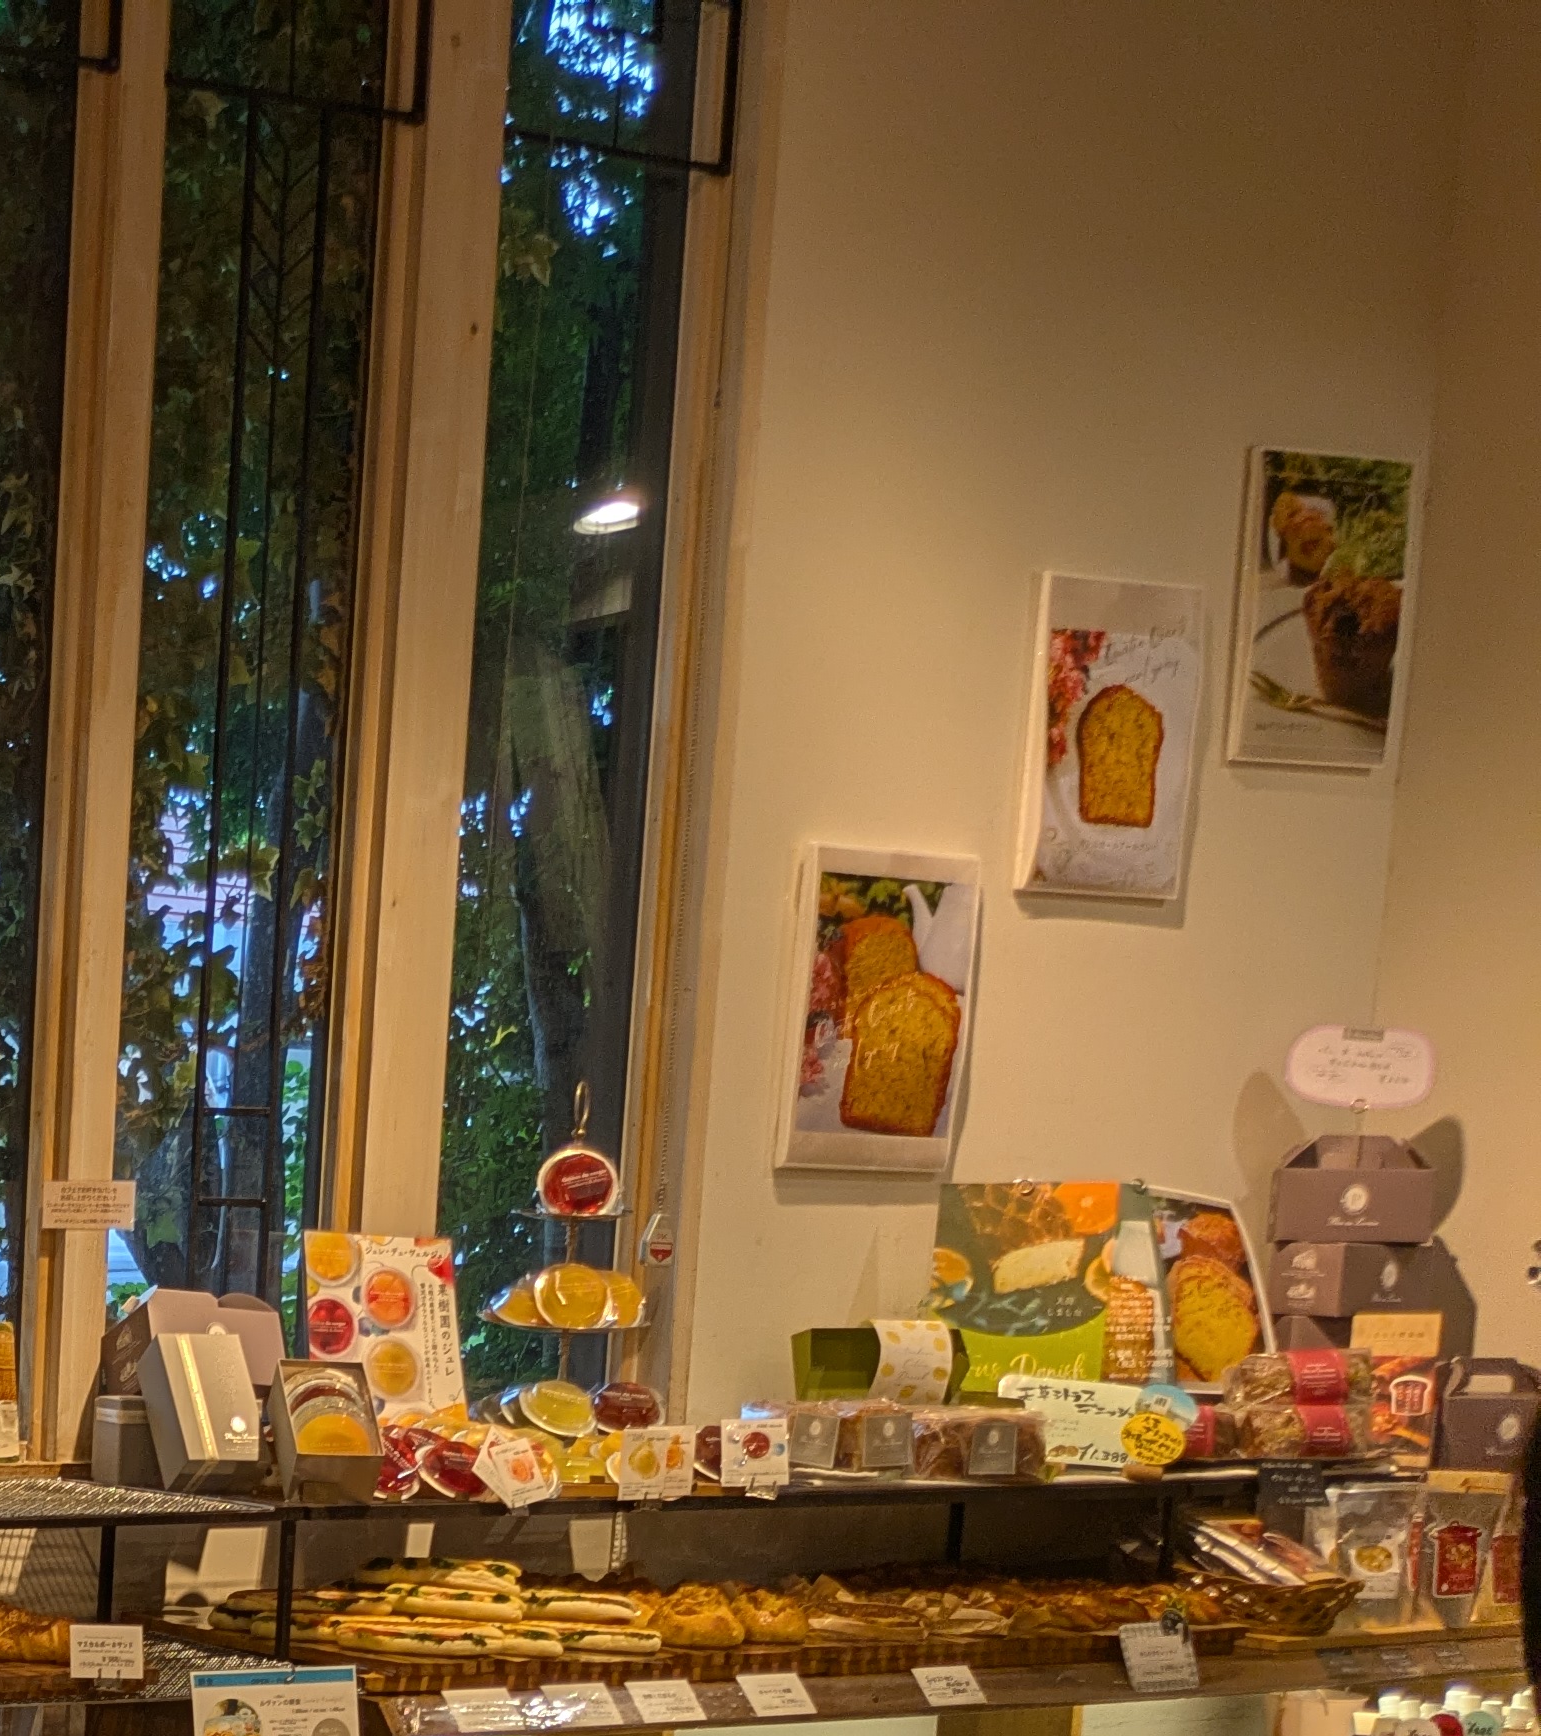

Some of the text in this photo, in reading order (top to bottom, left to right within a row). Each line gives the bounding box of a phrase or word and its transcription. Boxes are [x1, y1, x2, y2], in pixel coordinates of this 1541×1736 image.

[438, 1283, 456, 1377] 果樹園のジュレ
[1010, 1353, 1088, 1381] Danish
[1017, 1386, 1096, 1404] 天草シトラス
